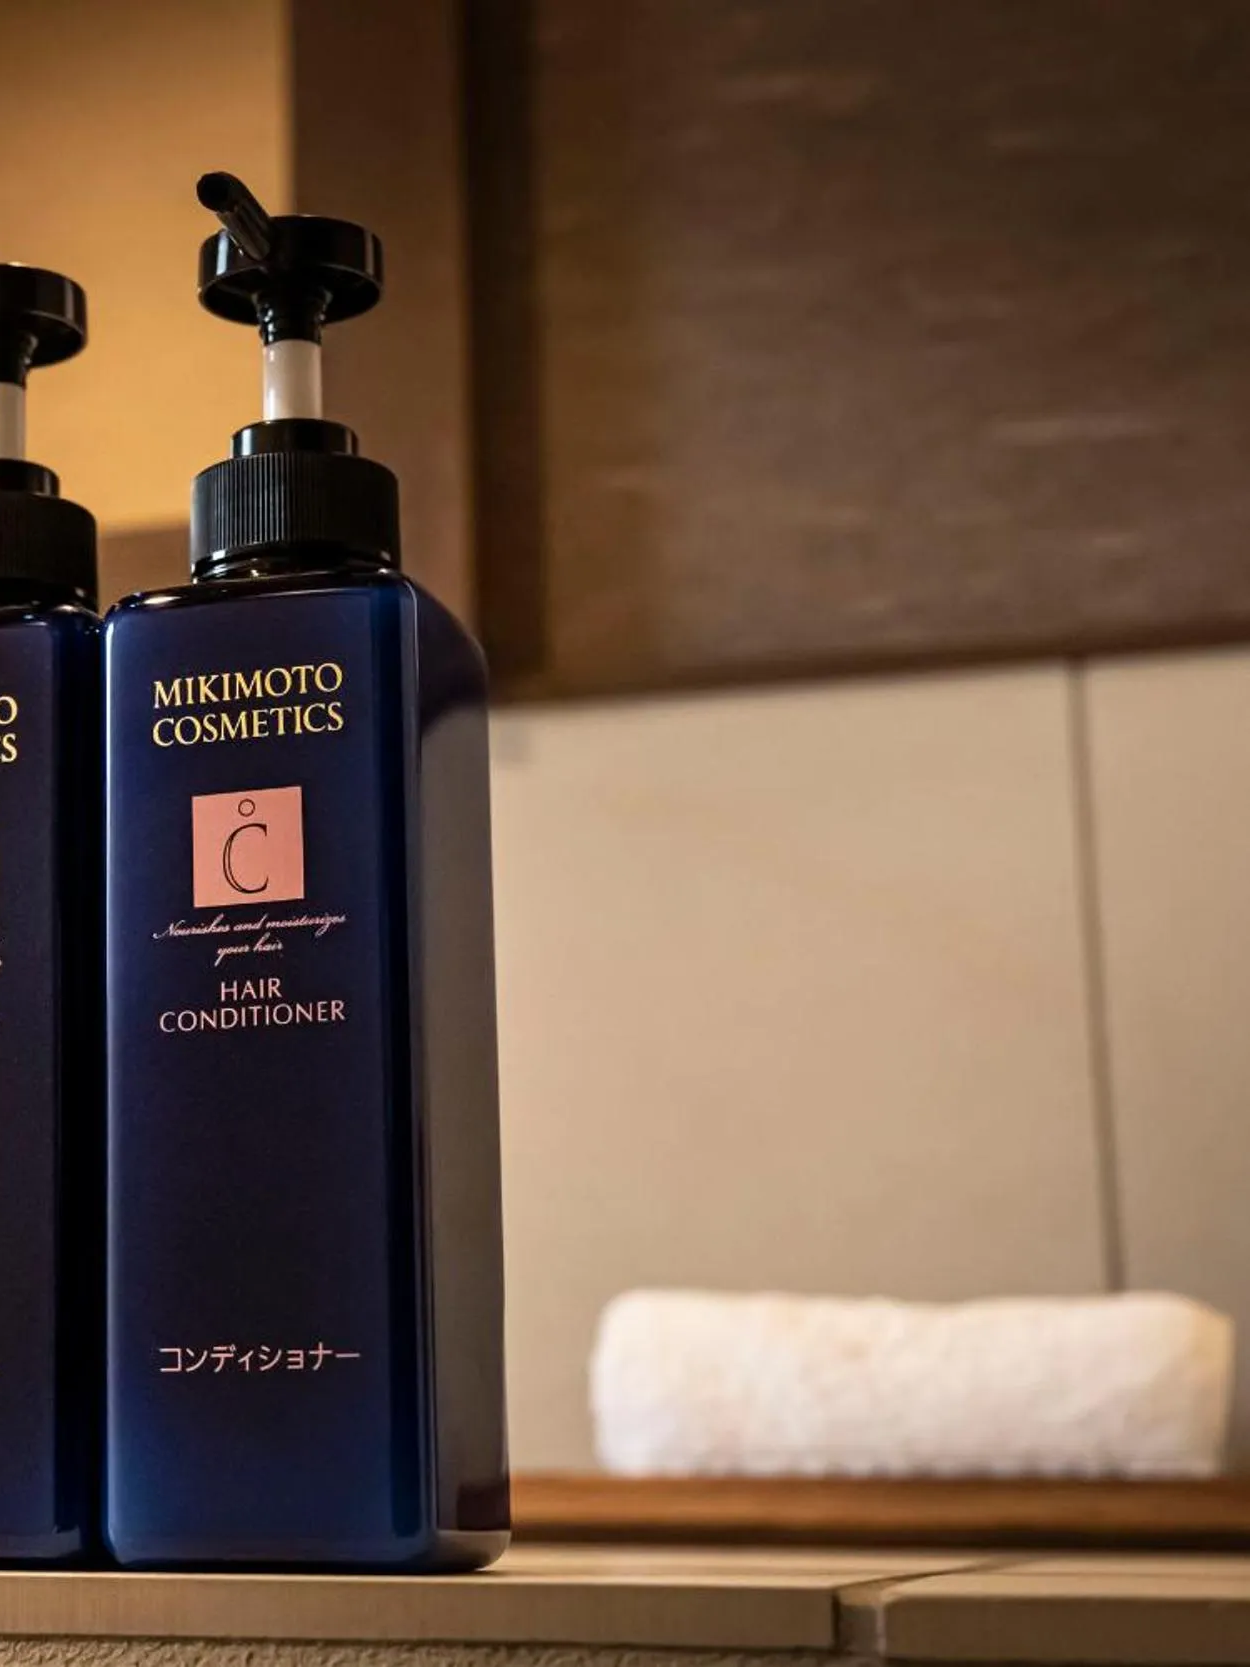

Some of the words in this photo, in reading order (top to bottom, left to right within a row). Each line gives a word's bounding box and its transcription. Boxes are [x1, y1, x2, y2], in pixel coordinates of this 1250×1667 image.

[153, 662, 343, 709] MIKIMOTO
[152, 701, 345, 748] COSMETICS
[152, 913, 231, 940] Nourishes
[232, 914, 268, 932] and
[266, 913, 347, 938] moisturizes
[214, 943, 250, 967] your
[252, 932, 283, 952] hair
[220, 977, 283, 1002] HAIR
[159, 999, 346, 1033] CONDITIONER
[159, 1341, 361, 1373] コンディショナー
